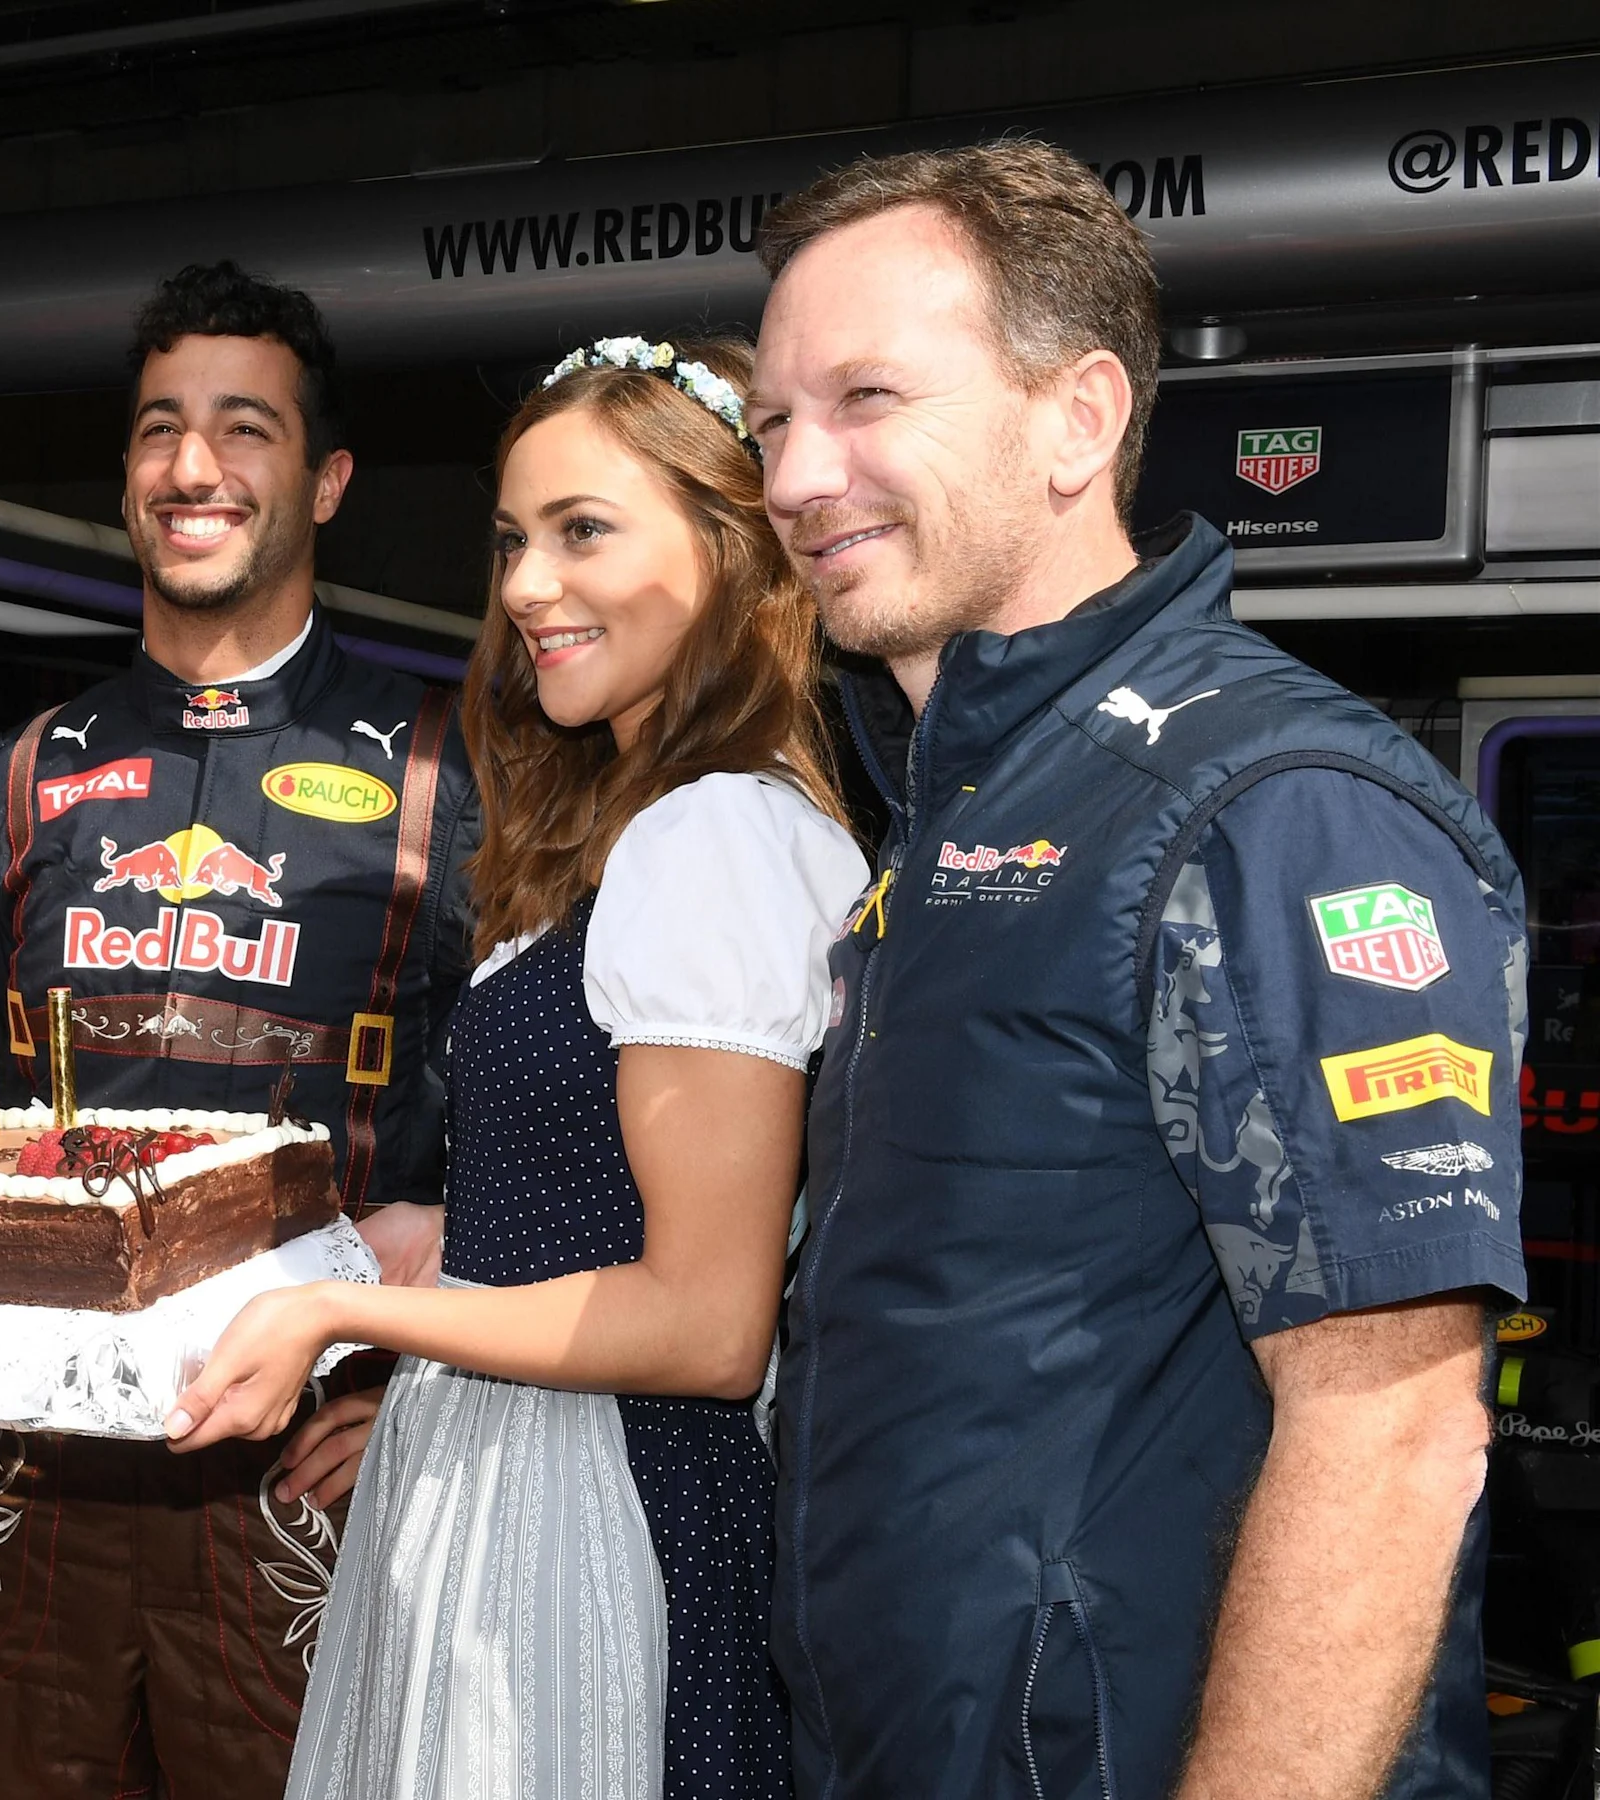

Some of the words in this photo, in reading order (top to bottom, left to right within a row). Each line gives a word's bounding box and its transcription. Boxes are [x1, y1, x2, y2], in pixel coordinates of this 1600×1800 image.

[1388, 117, 1600, 194] @RED
[423, 192, 781, 279] WWW.REDBU
[1089, 154, 1205, 218] OM
[1245, 432, 1313, 453] TAG
[1241, 457, 1314, 489] HEUER
[1226, 520, 1319, 535] Hisense
[184, 711, 215, 728] Red
[216, 707, 249, 727] Bull
[44, 771, 146, 810] TOTAL
[298, 778, 379, 810] RAUCH
[938, 842, 983, 871] Red
[1326, 892, 1431, 932] TAG
[67, 910, 176, 969] Red
[178, 911, 298, 985] Bull
[1336, 931, 1442, 980] HEUER
[1344, 1047, 1477, 1104] PIRELLI
[1379, 1191, 1453, 1222] ASTON
[1500, 1412, 1568, 1443] Pepe
